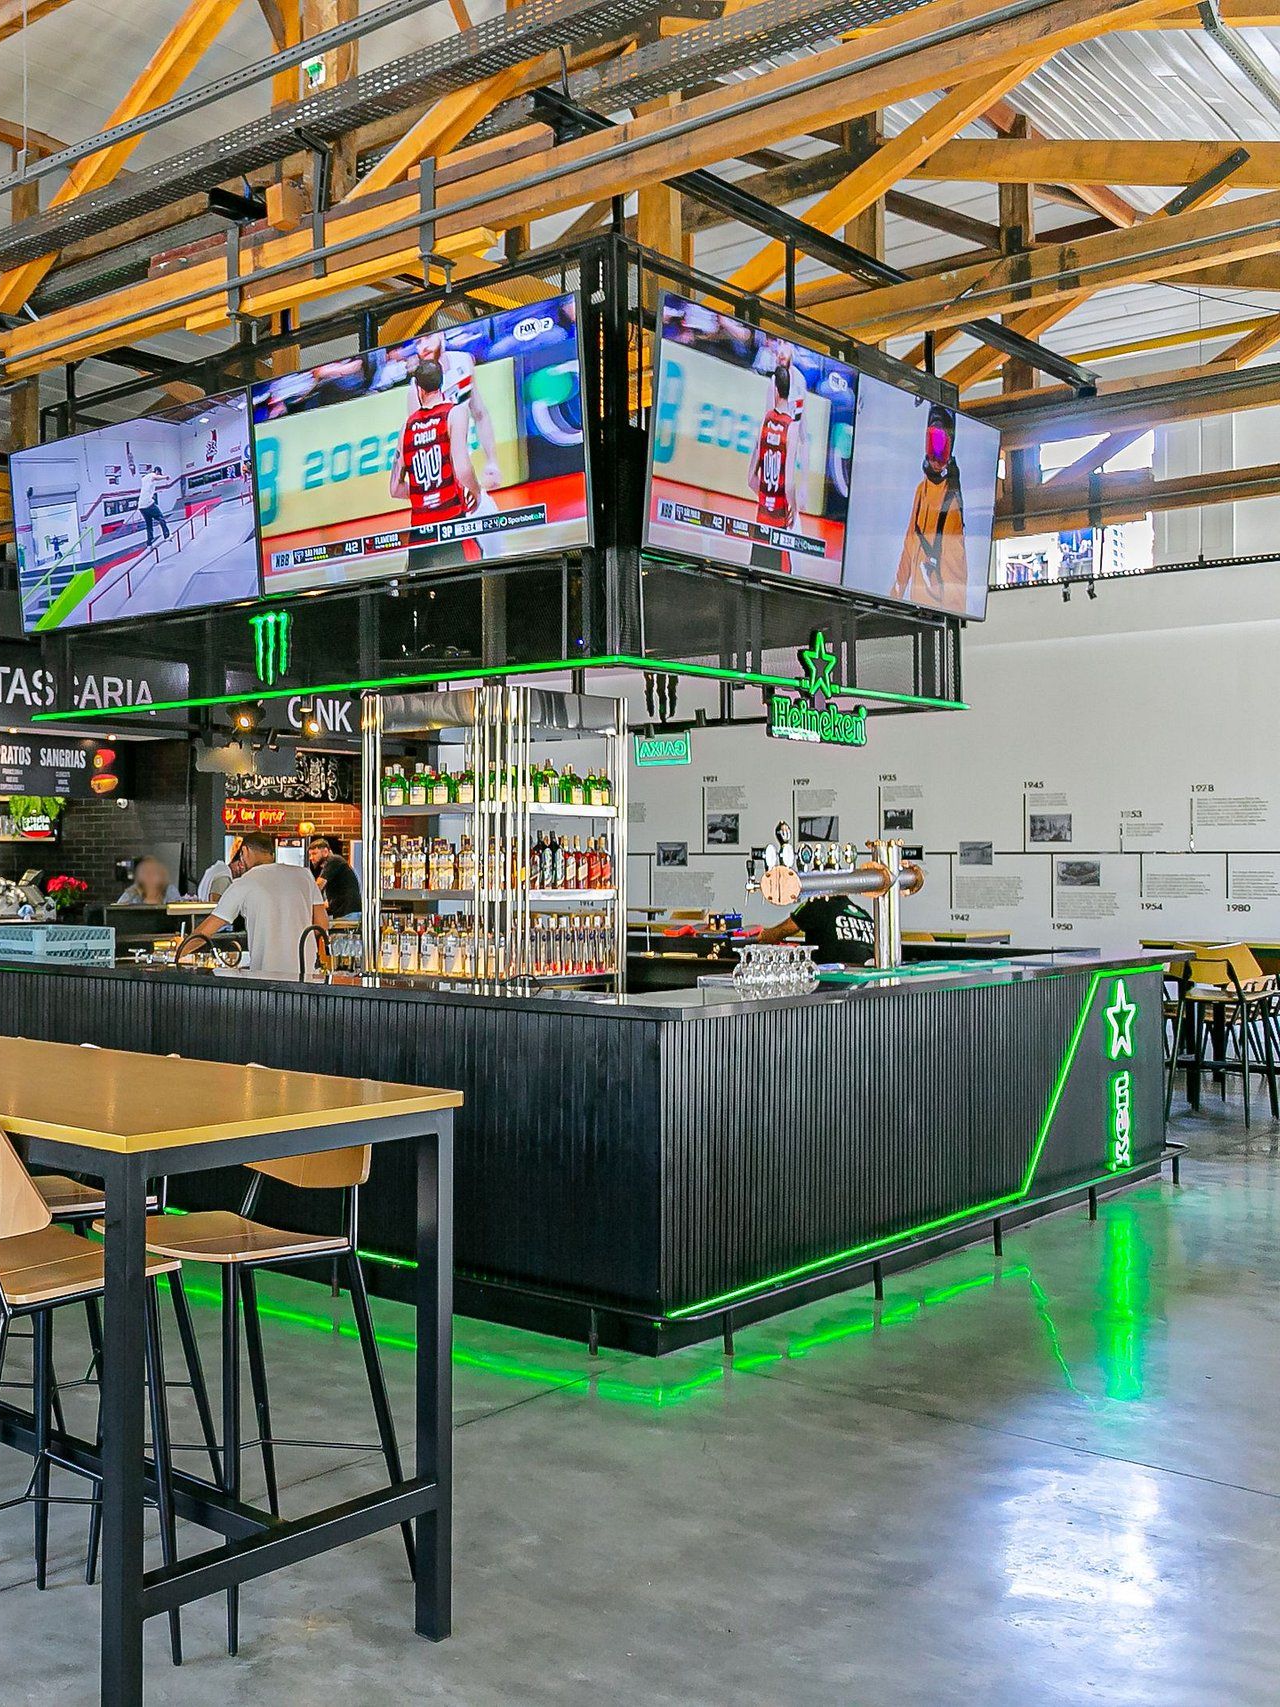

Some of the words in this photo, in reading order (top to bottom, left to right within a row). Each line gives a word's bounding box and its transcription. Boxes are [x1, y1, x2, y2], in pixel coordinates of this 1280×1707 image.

[520, 322, 536, 334] FOX
[345, 541, 359, 553] 42
[771, 695, 867, 746] Heineken
[40, 748, 86, 769] SANGRIAS
[1120, 810, 1142, 818] 153
[1226, 904, 1251, 912] 1980
[835, 915, 874, 931] GREE
[1052, 923, 1073, 931] 1950
